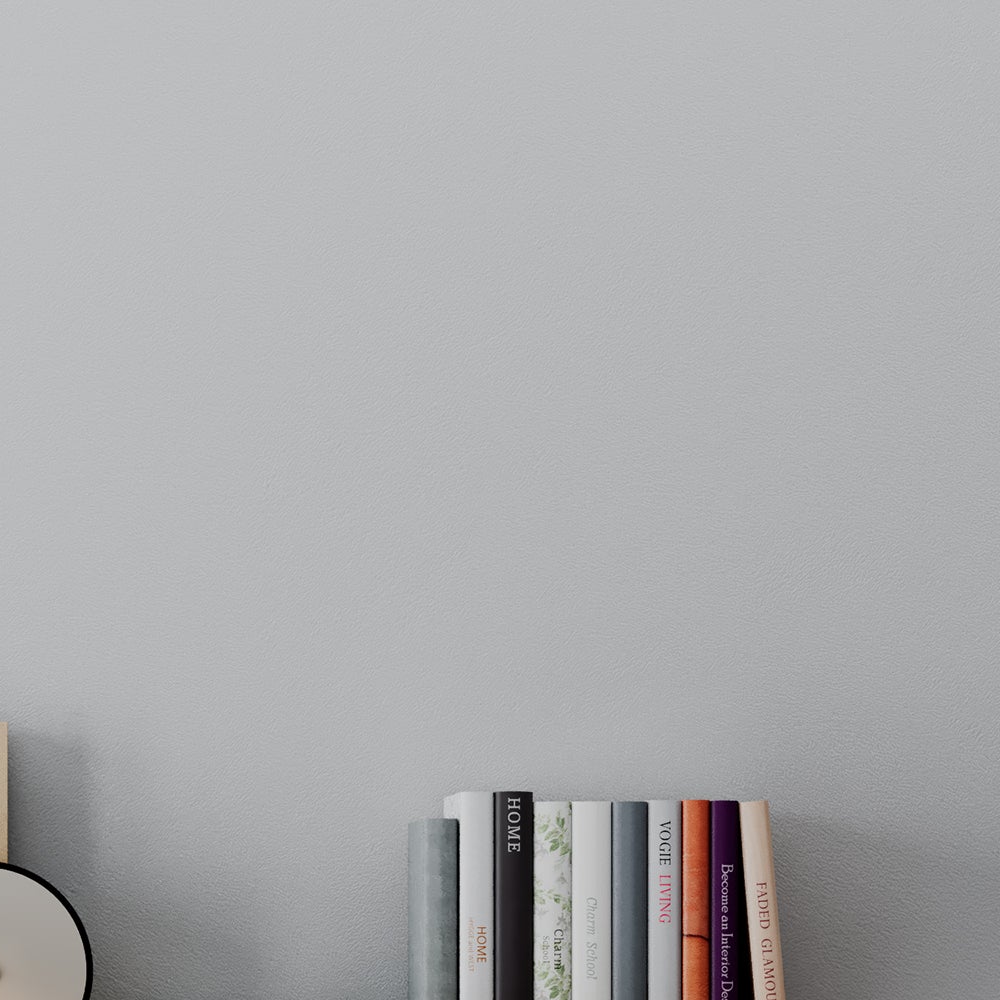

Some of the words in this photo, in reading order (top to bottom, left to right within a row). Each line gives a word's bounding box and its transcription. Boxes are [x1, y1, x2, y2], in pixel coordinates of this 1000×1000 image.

[507, 797, 521, 853] HOME
[658, 820, 672, 866] VOGIE
[658, 874, 672, 924] LIVING
[721, 864, 734, 914] Become
[756, 882, 771, 930] FADED
[586, 896, 598, 935] Charm
[721, 916, 729, 930] an
[476, 926, 487, 963] HOME
[553, 928, 564, 970] Charm
[586, 942, 598, 981] School
[721, 933, 734, 979] Interior
